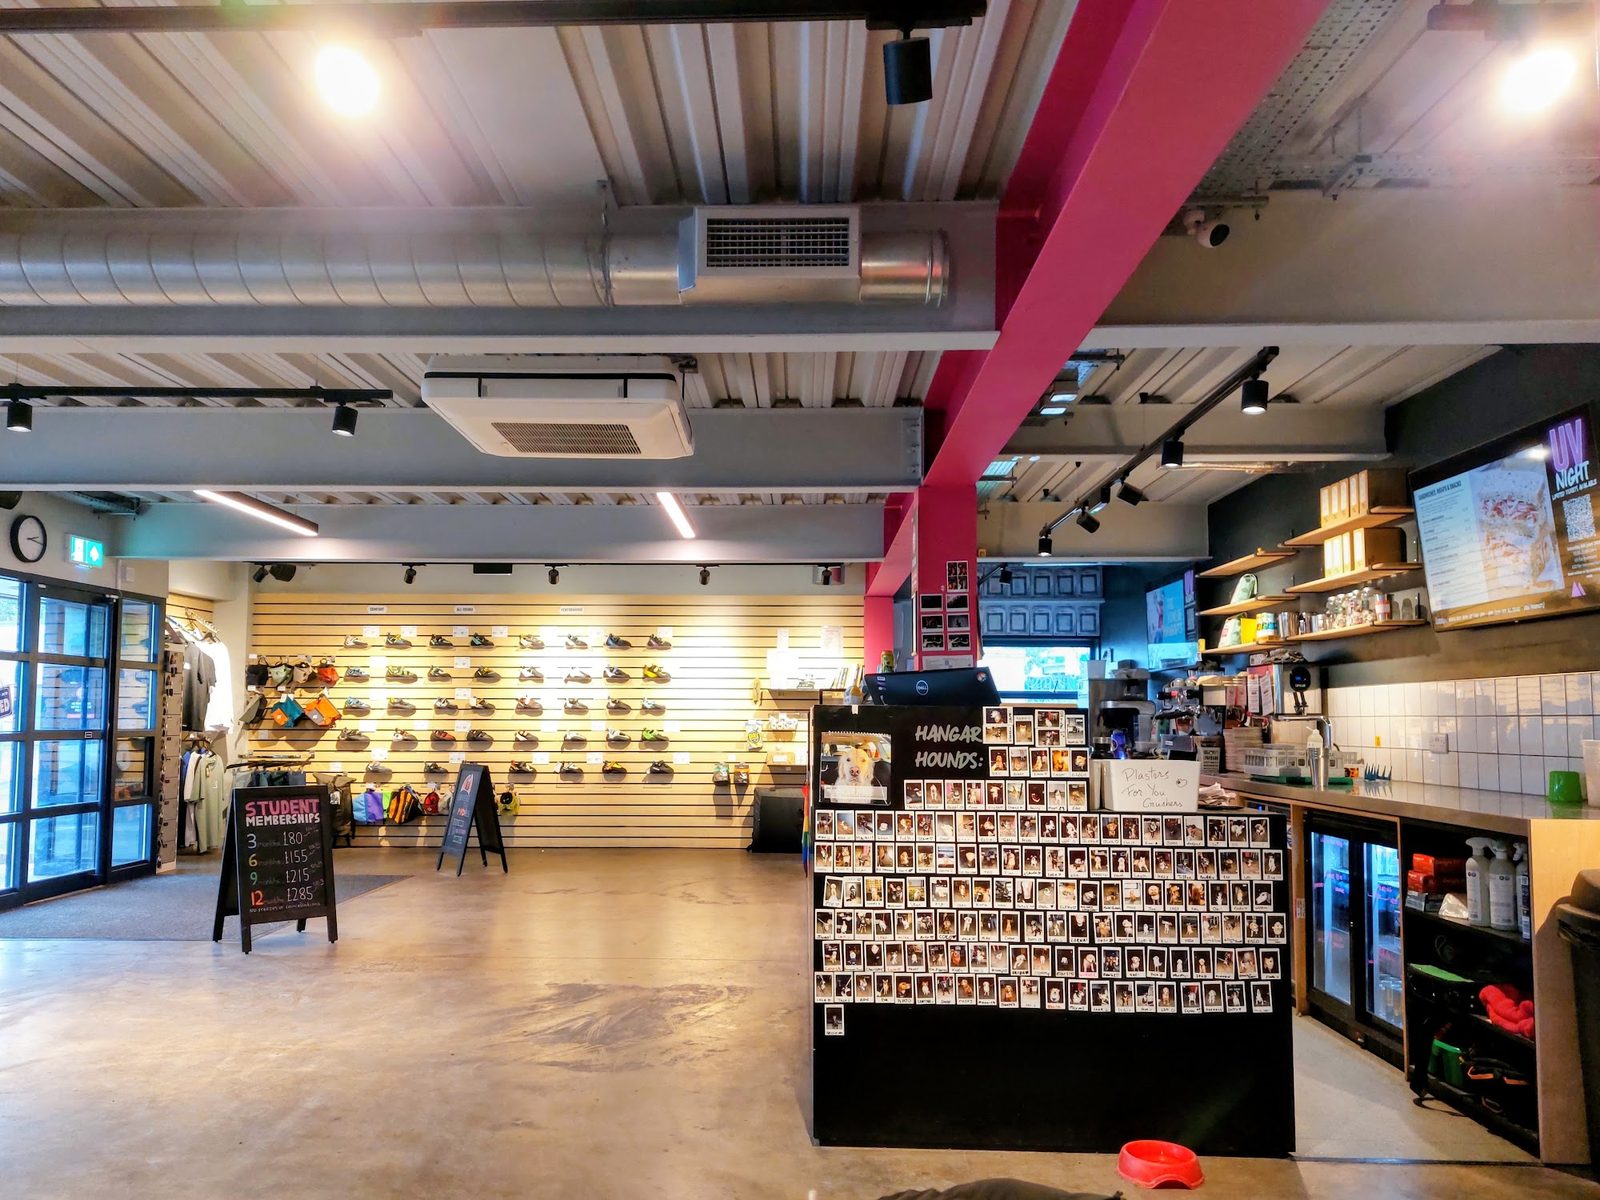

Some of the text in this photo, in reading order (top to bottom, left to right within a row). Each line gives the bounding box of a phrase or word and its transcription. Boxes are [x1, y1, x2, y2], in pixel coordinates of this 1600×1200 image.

[1549, 419, 1583, 472] UV
[1555, 460, 1589, 492] NIGHT
[915, 724, 983, 743] HANGAR
[915, 750, 984, 769] HOUNDS:
[1121, 783, 1165, 797] For You
[245, 799, 320, 817] STUDENT
[1142, 797, 1183, 808] Crushers
[246, 813, 320, 827] MEMBERSHIPS
[246, 833, 257, 849] 3
[248, 853, 258, 867] 6
[250, 872, 258, 886] 9
[251, 890, 265, 906] 12
